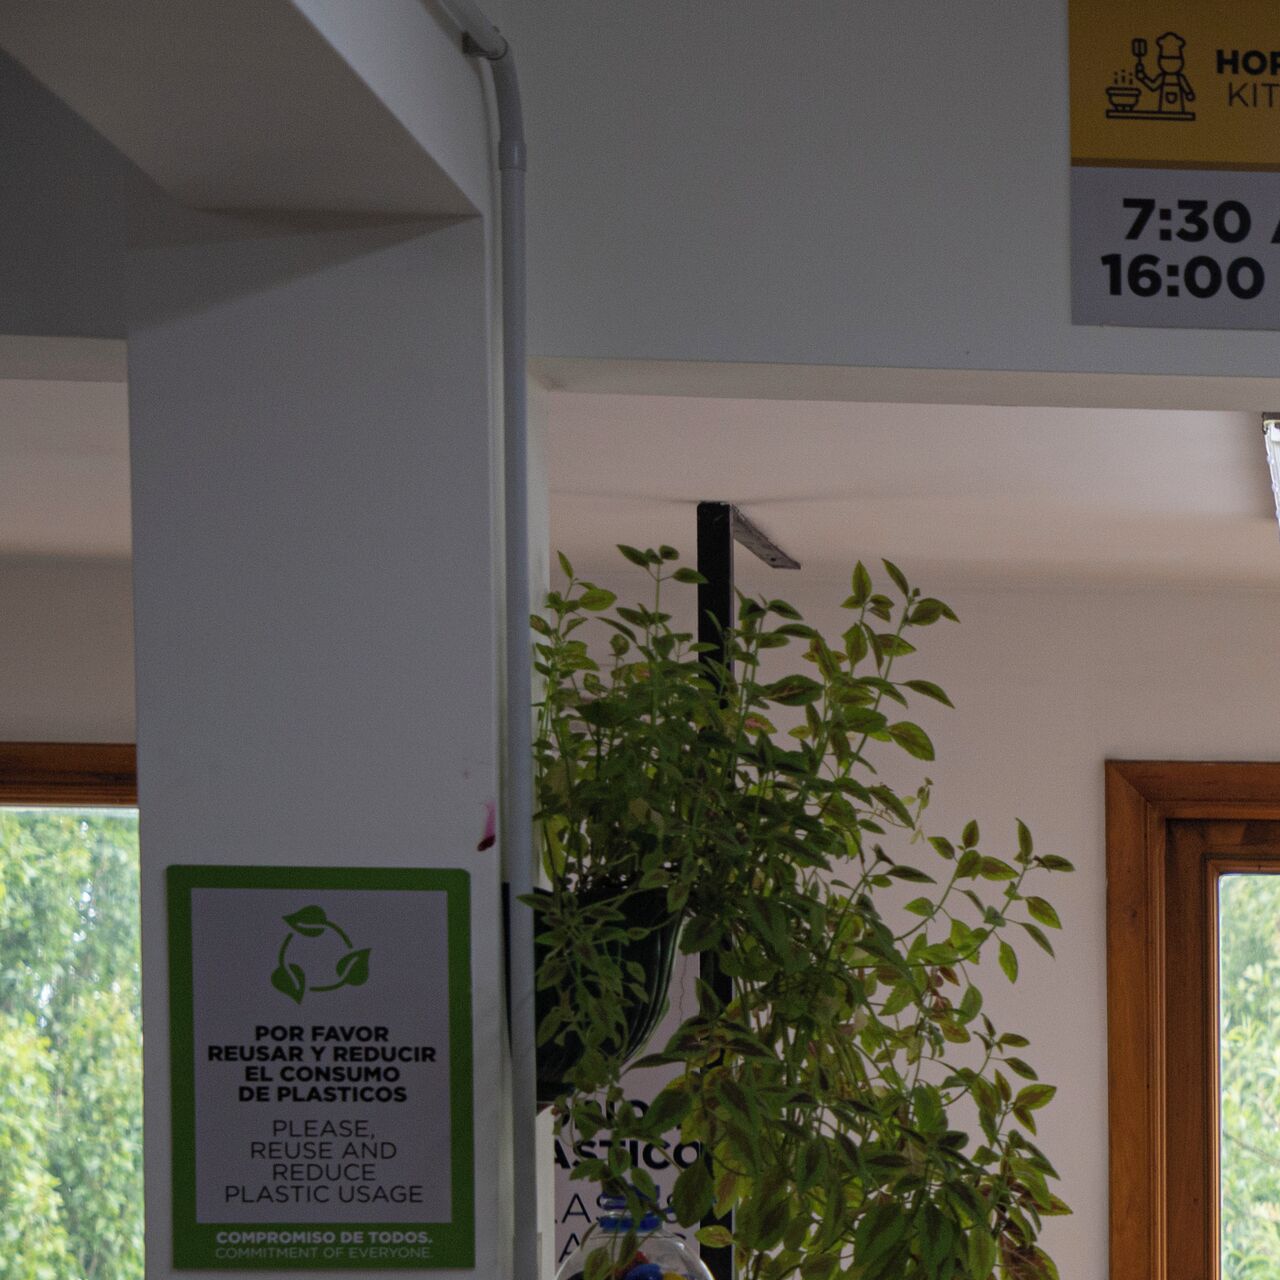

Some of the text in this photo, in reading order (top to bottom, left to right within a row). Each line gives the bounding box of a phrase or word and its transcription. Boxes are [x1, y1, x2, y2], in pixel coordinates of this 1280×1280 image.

[1123, 198, 1251, 243] 7:30
[1101, 254, 1264, 299] 16:00
[256, 1026, 389, 1042] POR FAVOR
[208, 1046, 436, 1062] REUSAR Y REDUCIR
[245, 1066, 400, 1082] EL CONSUMO
[239, 1086, 407, 1102] DE PLASTICOS
[273, 1120, 374, 1139] PLEASE,
[251, 1142, 396, 1159] REUSE AND
[273, 1163, 375, 1181] REDUCE
[225, 1185, 423, 1203] PLASTIC USAGE
[216, 1232, 432, 1243] COMPROMISO DE TODOS.
[216, 1247, 318, 1259] COMMITMENT
[323, 1247, 343, 1258] OF
